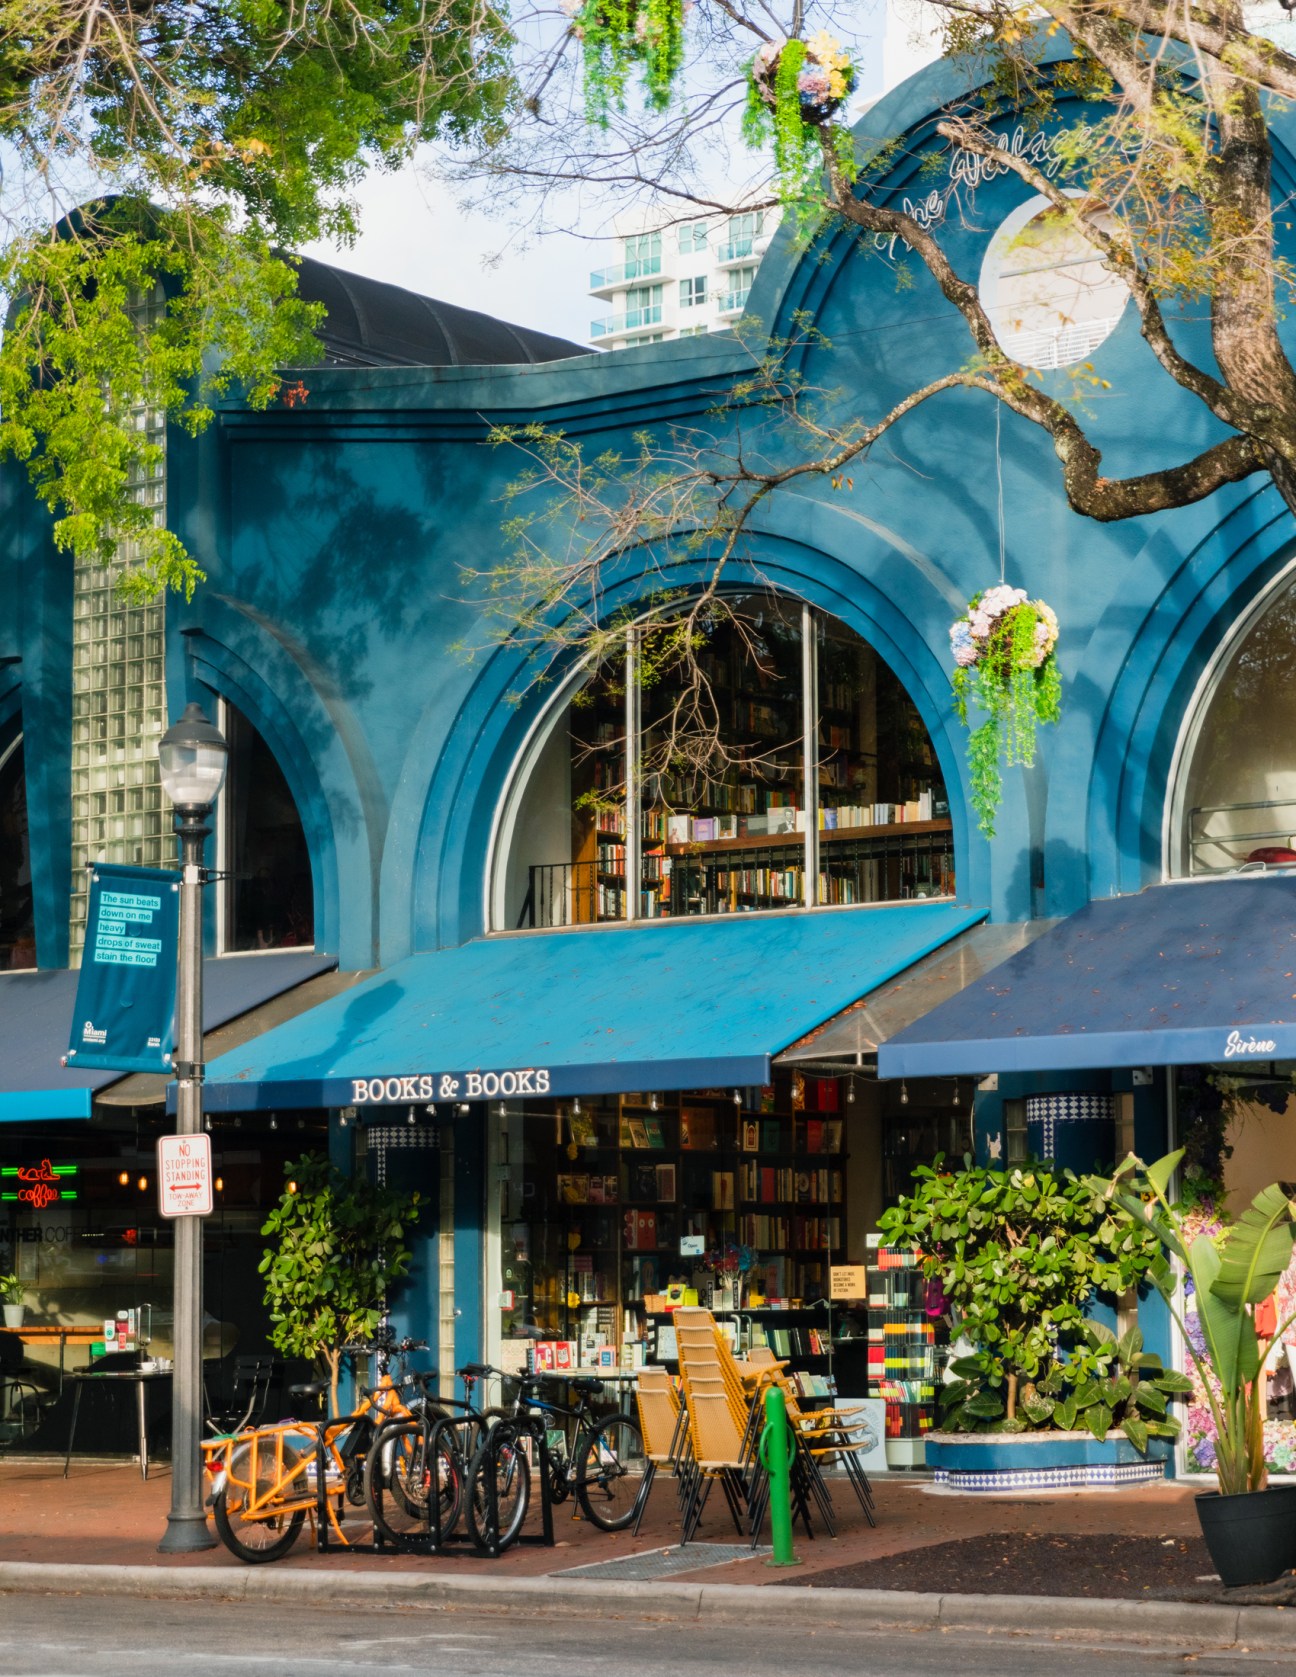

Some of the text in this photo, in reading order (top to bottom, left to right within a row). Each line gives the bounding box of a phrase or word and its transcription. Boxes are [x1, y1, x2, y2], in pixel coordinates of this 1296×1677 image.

[102, 893, 118, 903] The
[136, 897, 159, 907] beats
[100, 908, 124, 918] down
[138, 913, 151, 921] me
[99, 923, 125, 934] heavy
[98, 937, 160, 950] drops of sweat
[96, 952, 155, 964] stain the floor
[83, 1028, 107, 1037] Miami
[1224, 1030, 1277, 1057] Sirène
[352, 1069, 550, 1102] BOOKS & BOOKS
[179, 1144, 191, 1157] NO
[165, 1158, 206, 1170] STOPPING
[166, 1170, 206, 1182] STANDING
[18, 1184, 60, 1208] coffee
[169, 1191, 203, 1200] TOW-AWAY
[178, 1199, 195, 1207] ZONE
